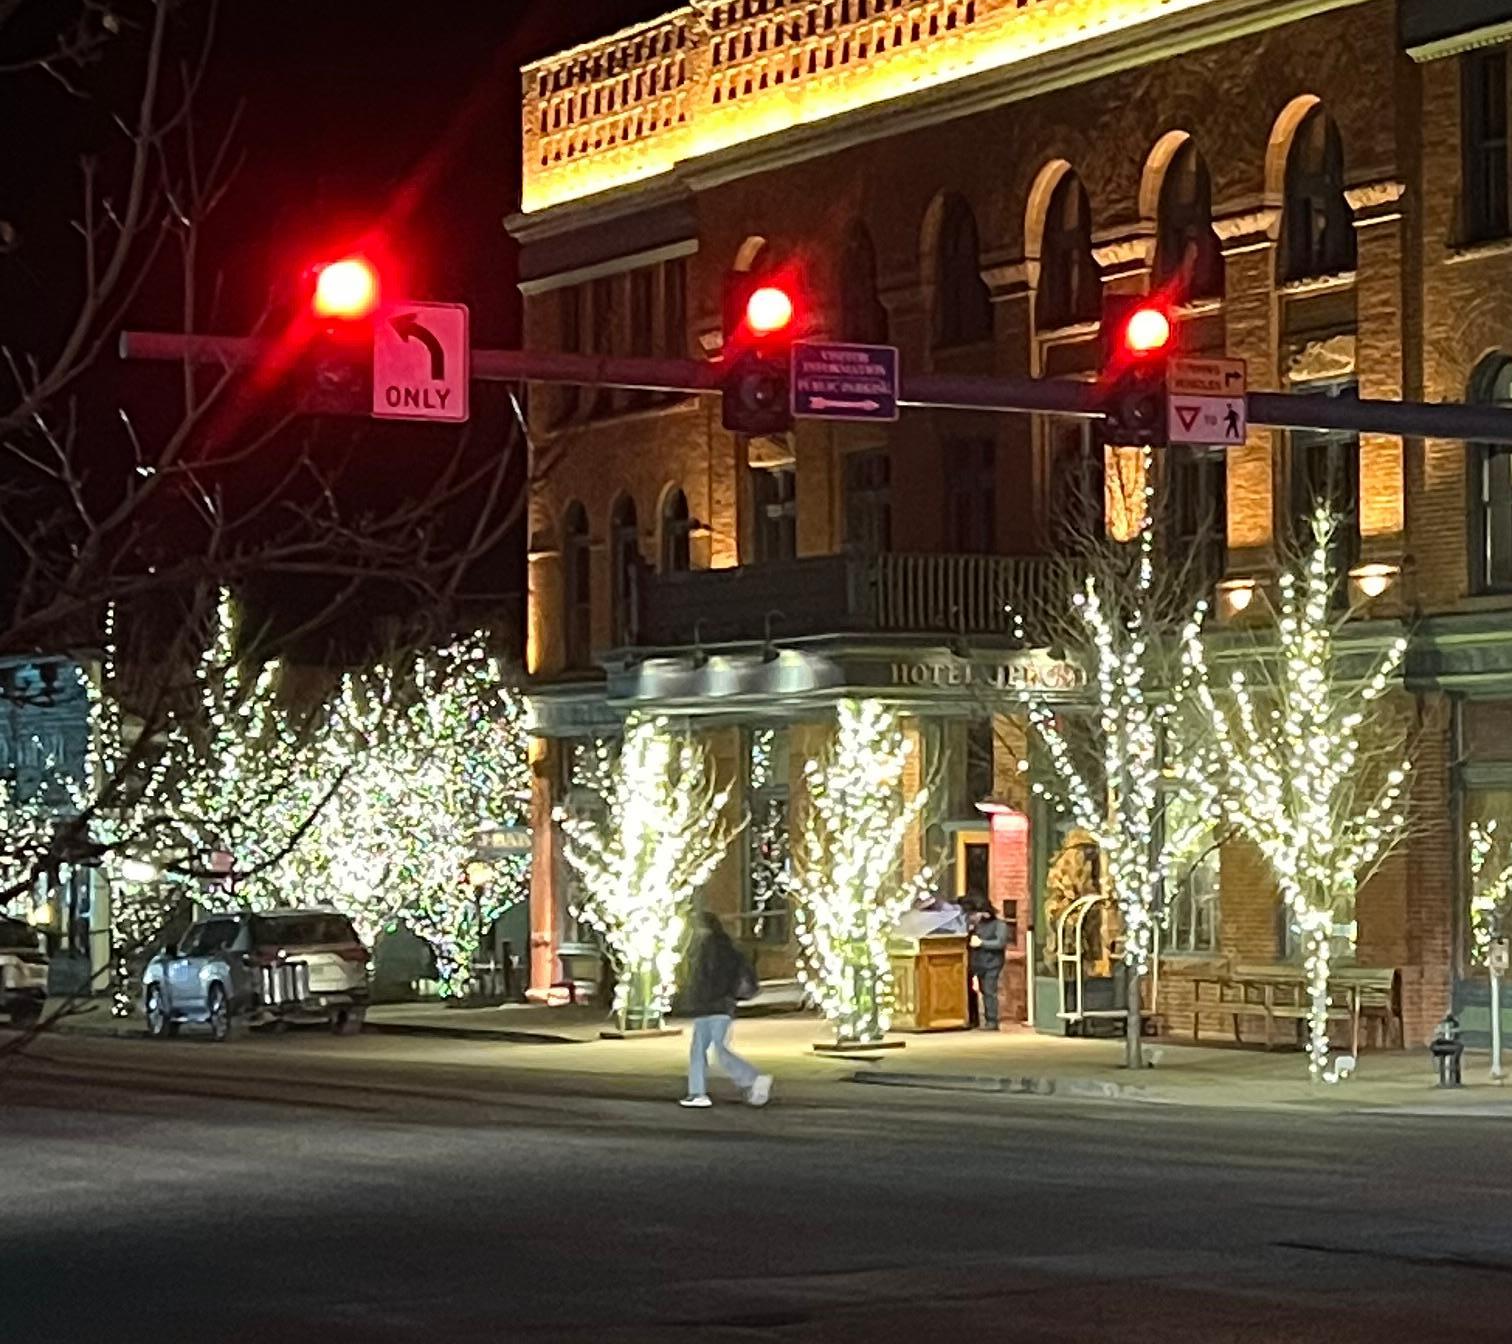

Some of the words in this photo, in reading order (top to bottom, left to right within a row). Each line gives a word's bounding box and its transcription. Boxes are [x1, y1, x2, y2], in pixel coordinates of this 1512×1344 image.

[821, 350, 870, 363] VISITOR
[802, 361, 886, 375] INFORMATION
[385, 385, 451, 410] ONLY
[1204, 414, 1218, 427] TO
[891, 663, 972, 688] HOTEL
